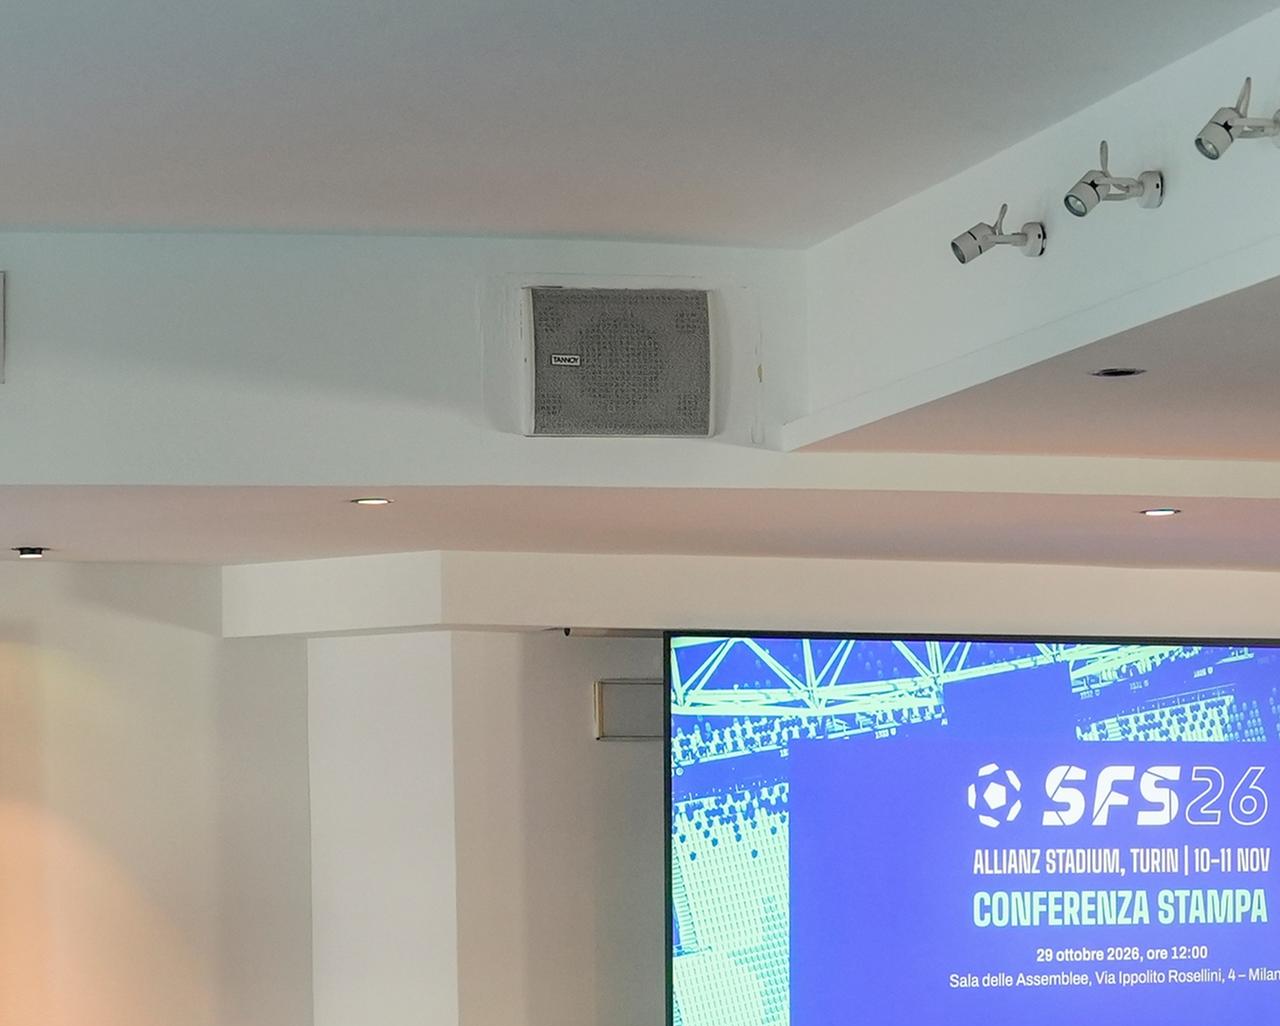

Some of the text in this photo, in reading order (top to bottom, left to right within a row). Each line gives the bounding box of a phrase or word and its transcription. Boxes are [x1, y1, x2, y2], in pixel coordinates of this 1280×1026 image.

[1042, 765, 1268, 826] SFS26
[973, 849, 1040, 874] ALLIANZ
[1046, 848, 1126, 877] STADIUM,
[1130, 847, 1178, 872] TURIN
[1238, 848, 1270, 871] NOV
[973, 888, 1268, 928] CONFERENZA STAMPA
[1037, 945, 1208, 962] 29 ottobre 2026, ore 12:00
[949, 974, 979, 988] Sala
[982, 973, 1013, 987] delle
[1016, 972, 1092, 987] Assemblee,
[1095, 971, 1116, 984] Via
[1119, 971, 1166, 986] Ippolito
[1169, 969, 1225, 984] Rosellini,
[1228, 970, 1236, 981] 4
